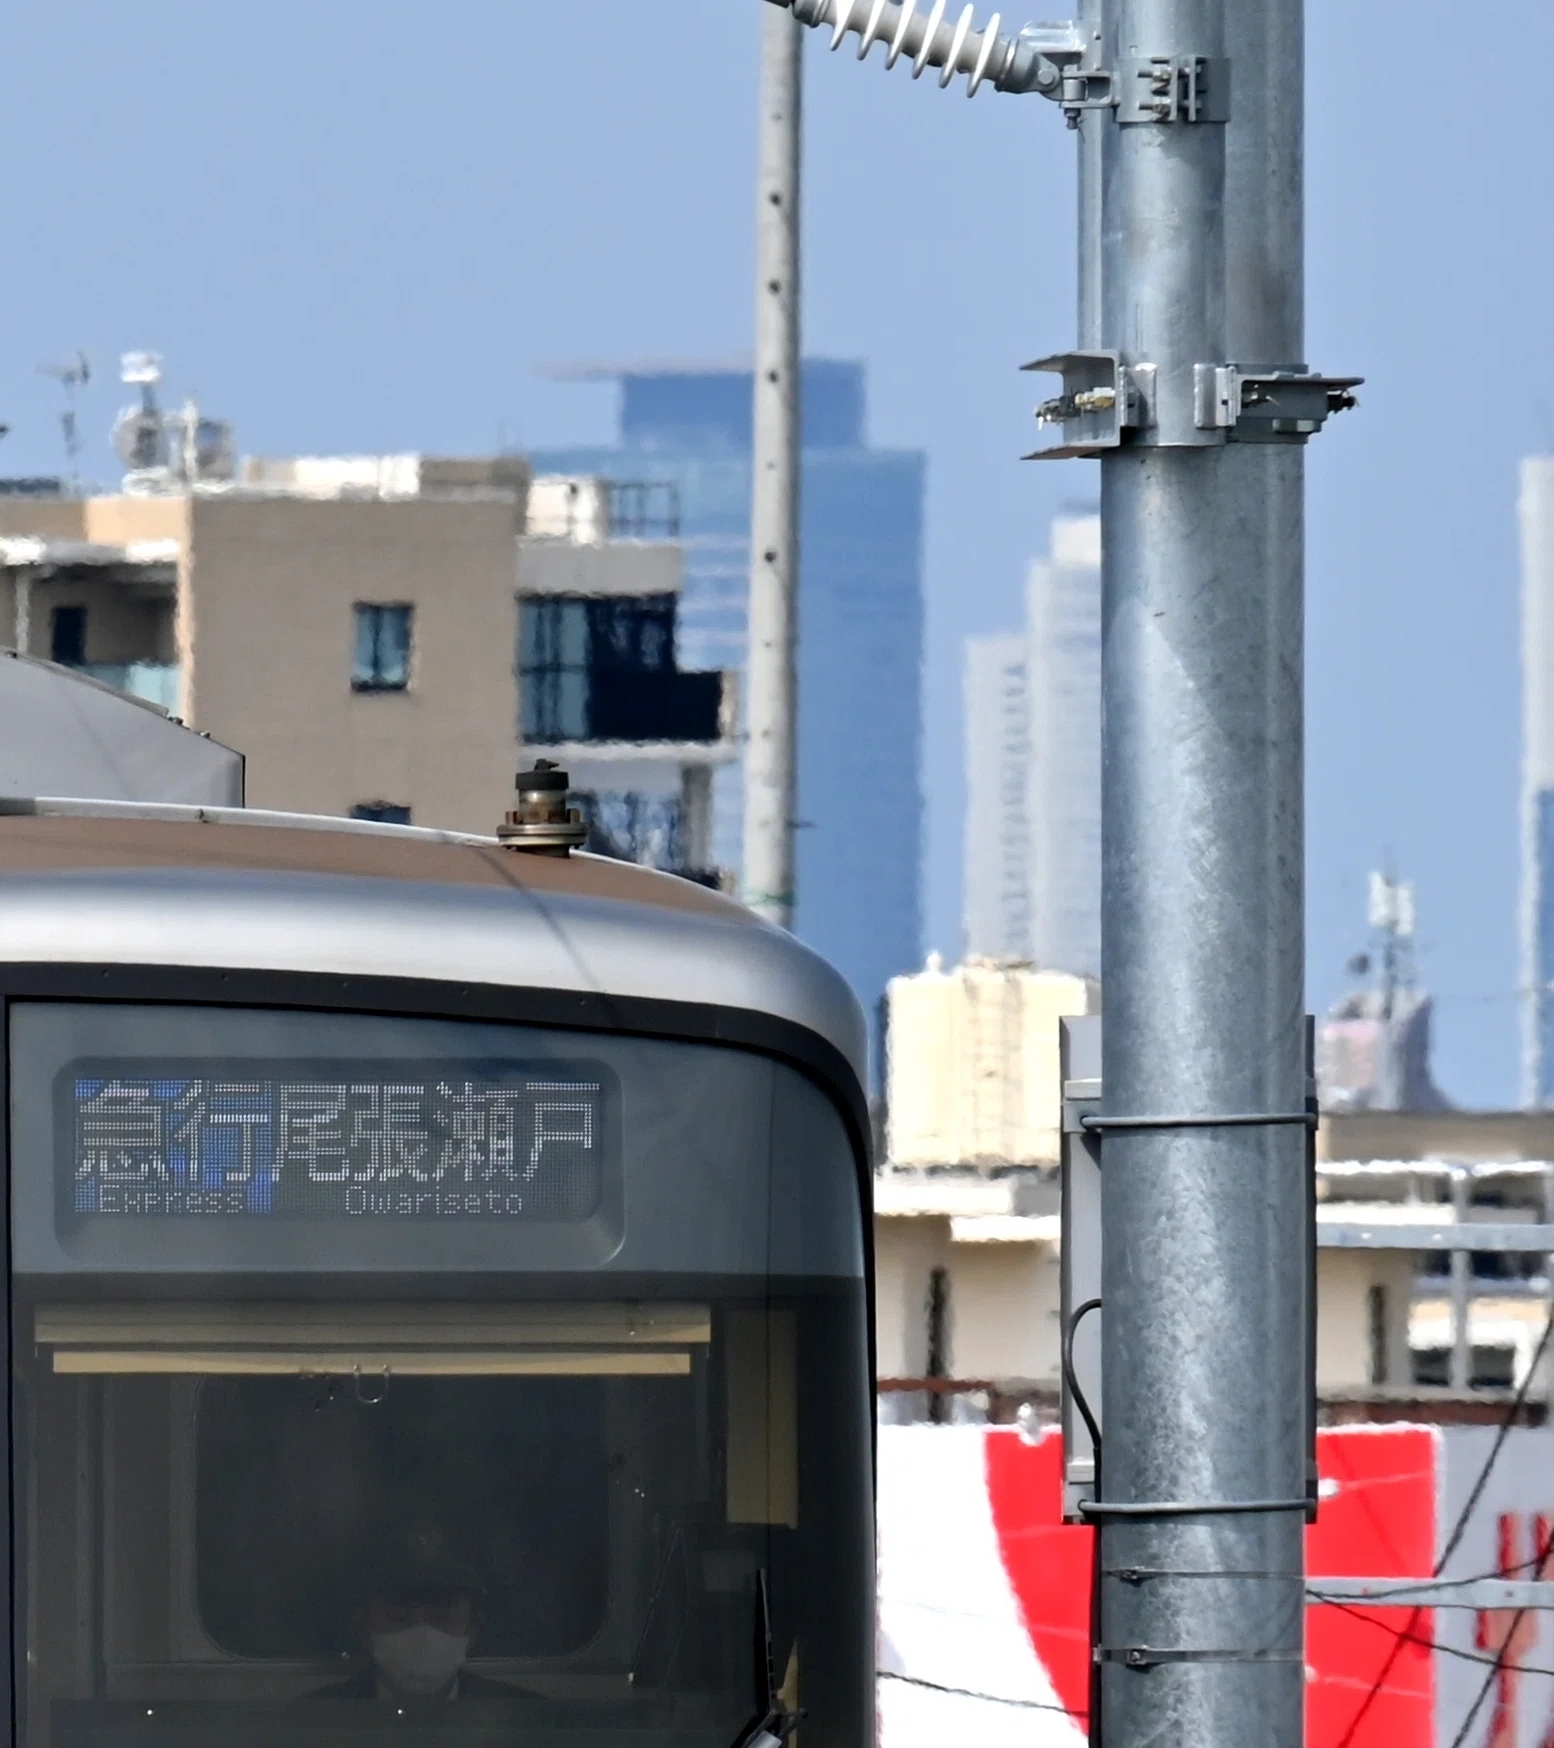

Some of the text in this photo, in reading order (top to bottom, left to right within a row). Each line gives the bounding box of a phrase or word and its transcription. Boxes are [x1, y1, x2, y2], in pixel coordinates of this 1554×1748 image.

[74, 1080, 600, 1182] 急行 尾張瀬戸
[345, 1185, 522, 1215] Owariseto
